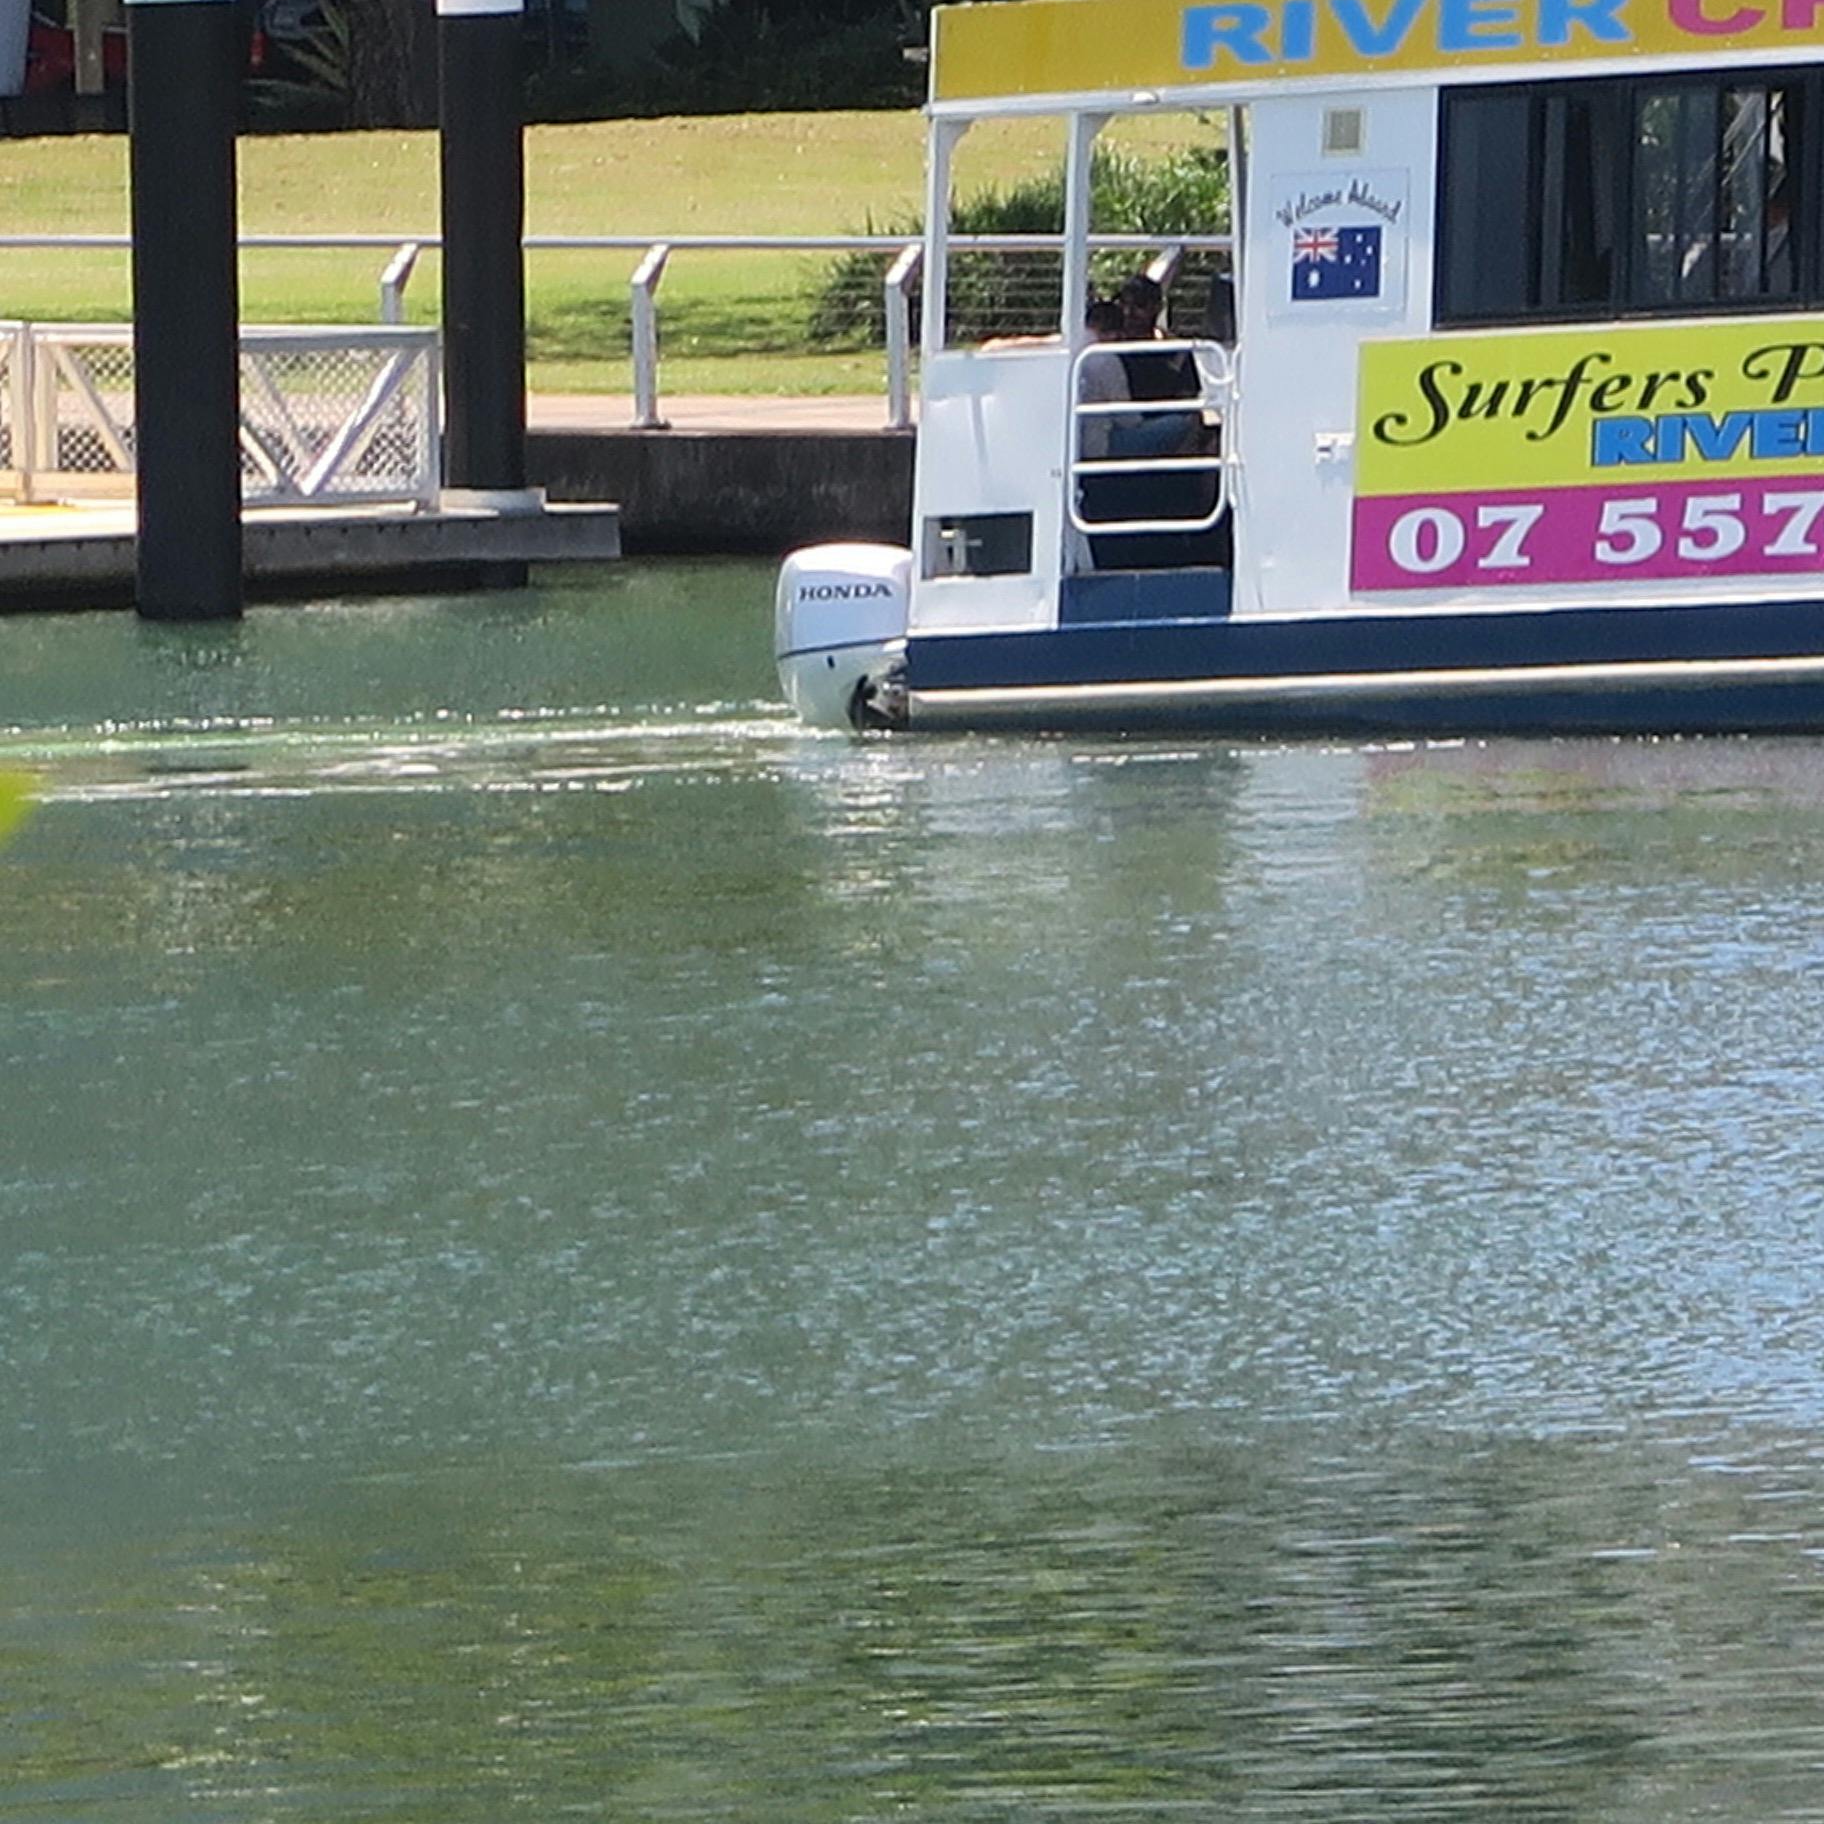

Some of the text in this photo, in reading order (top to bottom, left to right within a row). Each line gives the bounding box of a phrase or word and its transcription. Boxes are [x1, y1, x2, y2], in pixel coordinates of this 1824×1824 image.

[1275, 178, 1401, 228] Welcome Aboard
[1373, 352, 1714, 446] Surfers
[1388, 504, 1544, 573] 07
[800, 584, 892, 600] HONDA
